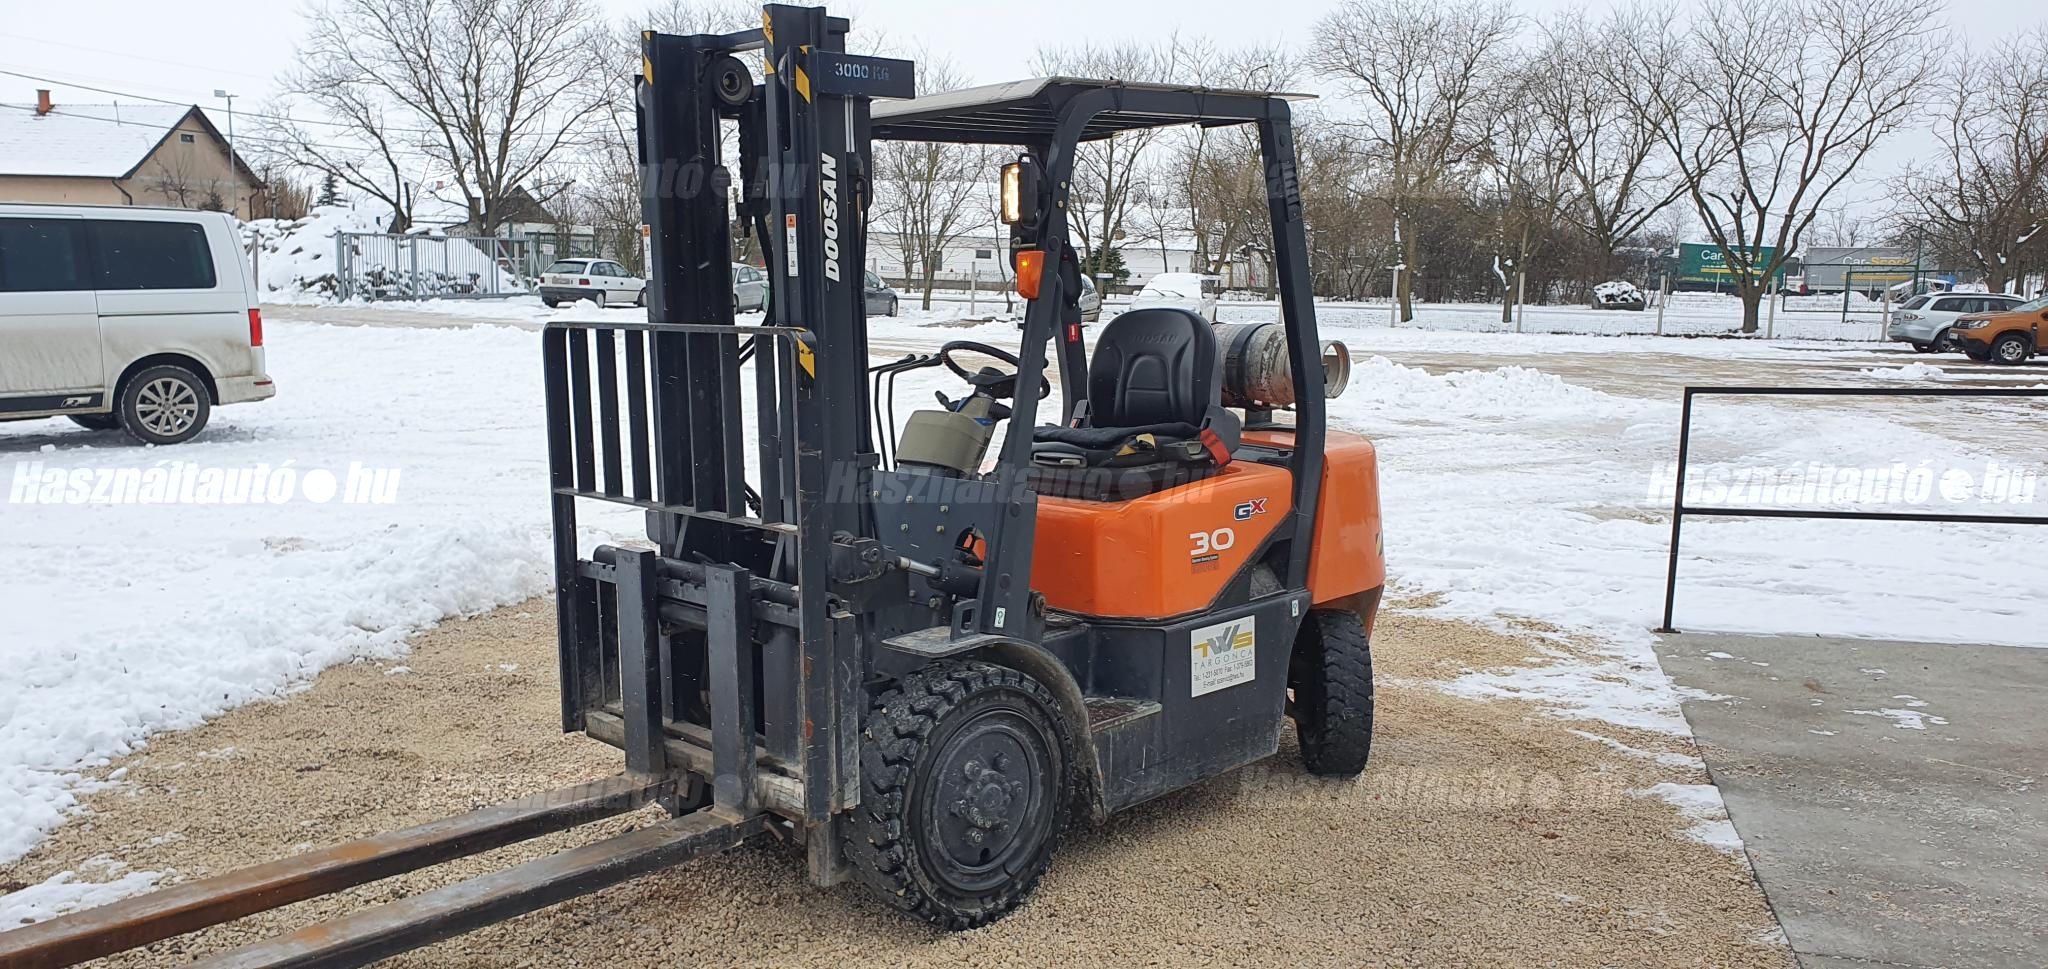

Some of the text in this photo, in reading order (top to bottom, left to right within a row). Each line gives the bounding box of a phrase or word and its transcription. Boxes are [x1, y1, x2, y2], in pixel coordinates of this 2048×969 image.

[834, 62, 869, 79] 3000
[821, 151, 840, 283] DOOSAN
[1233, 497, 1268, 521] GX
[1189, 527, 1235, 556] 30
[1193, 649, 1253, 672] TARGONCA
